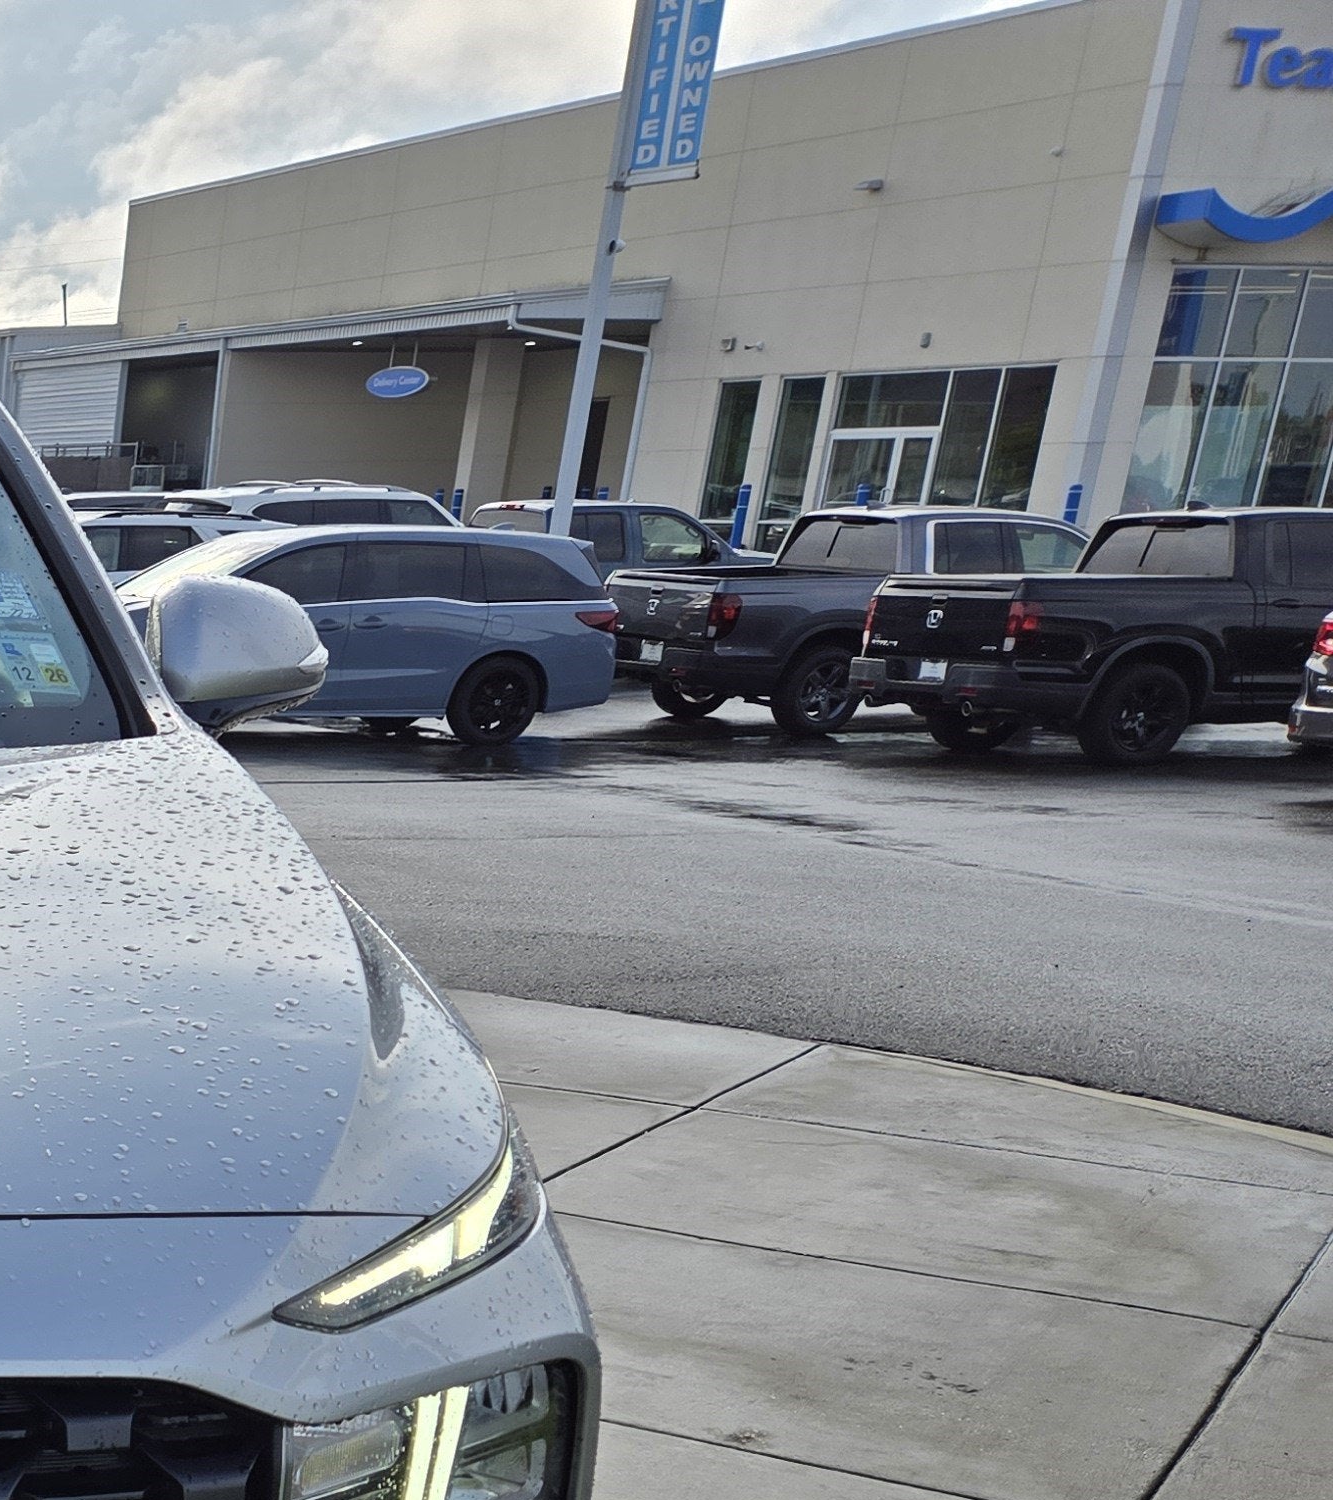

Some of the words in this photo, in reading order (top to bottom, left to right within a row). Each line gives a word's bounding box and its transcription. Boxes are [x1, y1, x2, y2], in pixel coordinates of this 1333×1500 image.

[675, 35, 711, 159] OWNED
[12, 666, 35, 681] 12
[45, 667, 69, 683] 26
